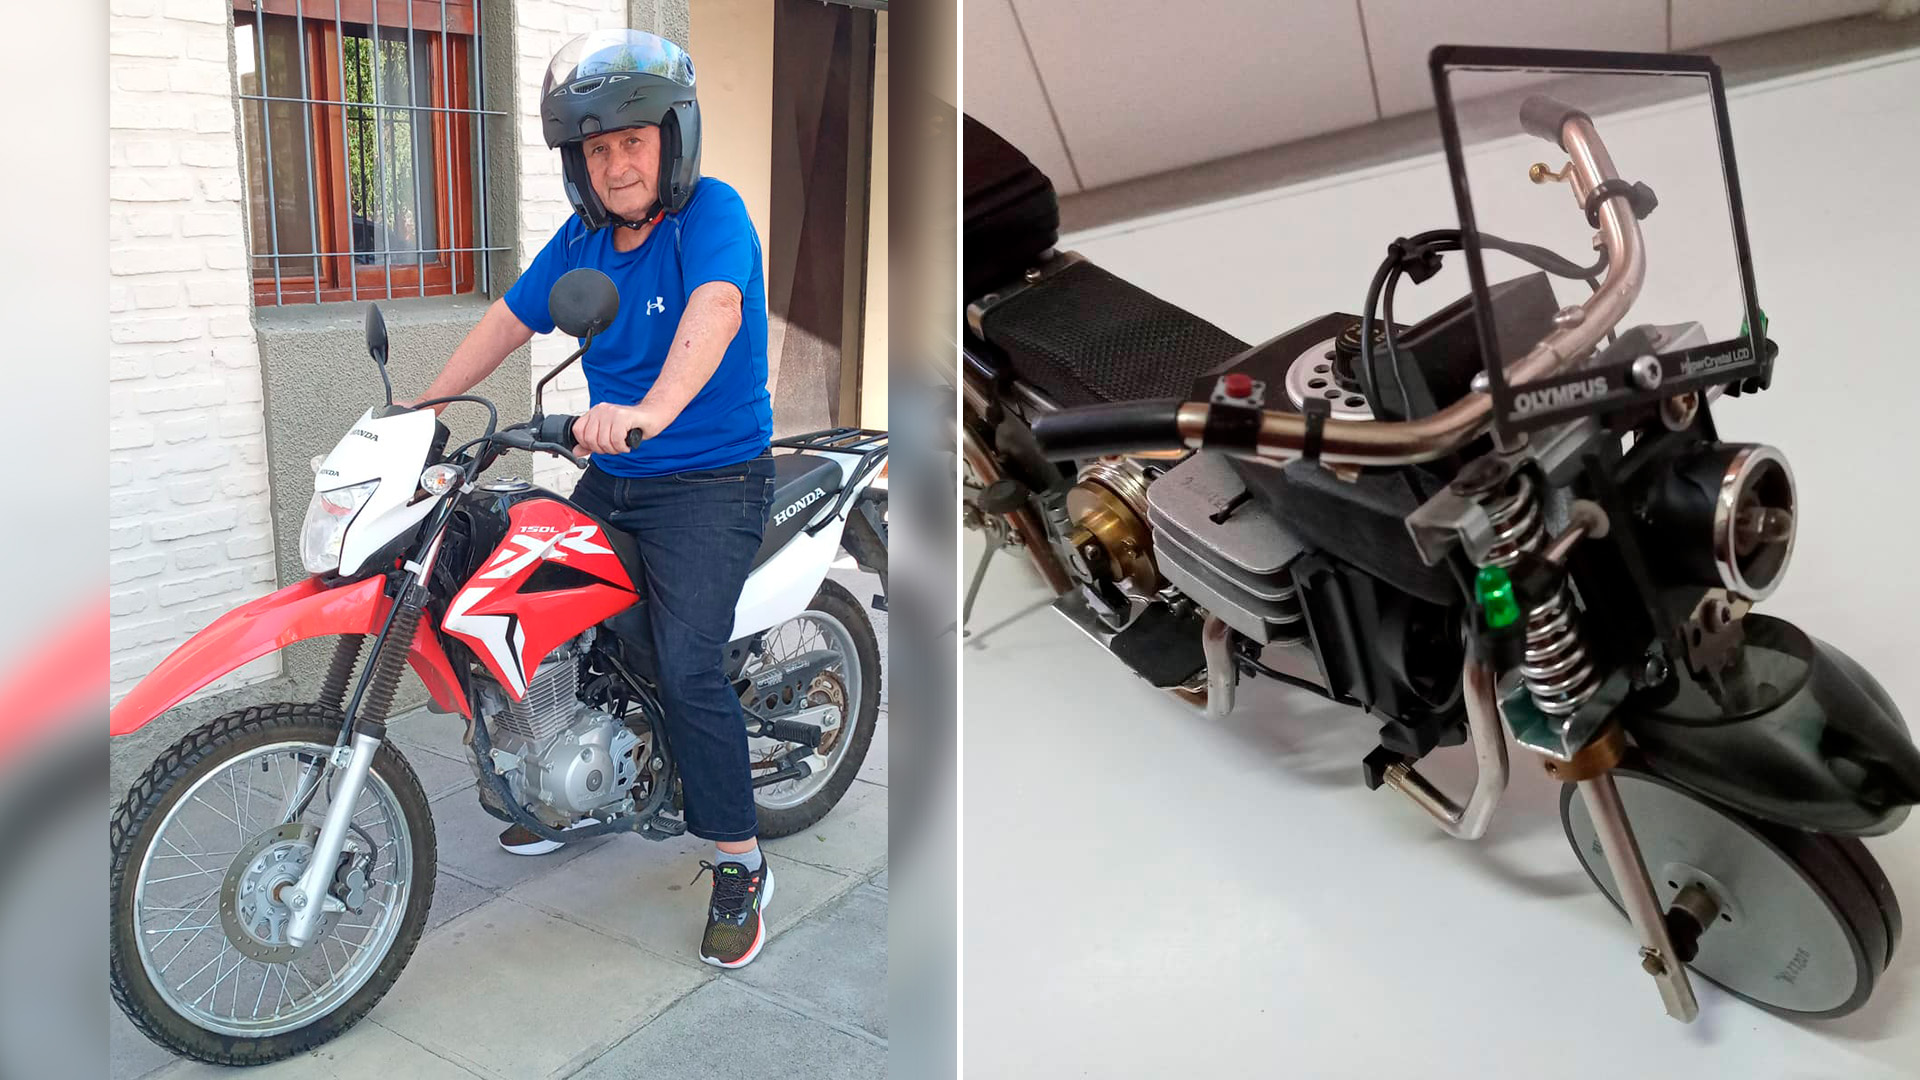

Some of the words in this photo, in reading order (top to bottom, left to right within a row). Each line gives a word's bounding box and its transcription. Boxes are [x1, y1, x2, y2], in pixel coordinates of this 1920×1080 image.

[1733, 348, 1750, 361] LCD
[1514, 376, 1608, 413] OLYMPUS
[773, 487, 826, 526] HONDA
[479, 524, 615, 579] XR
